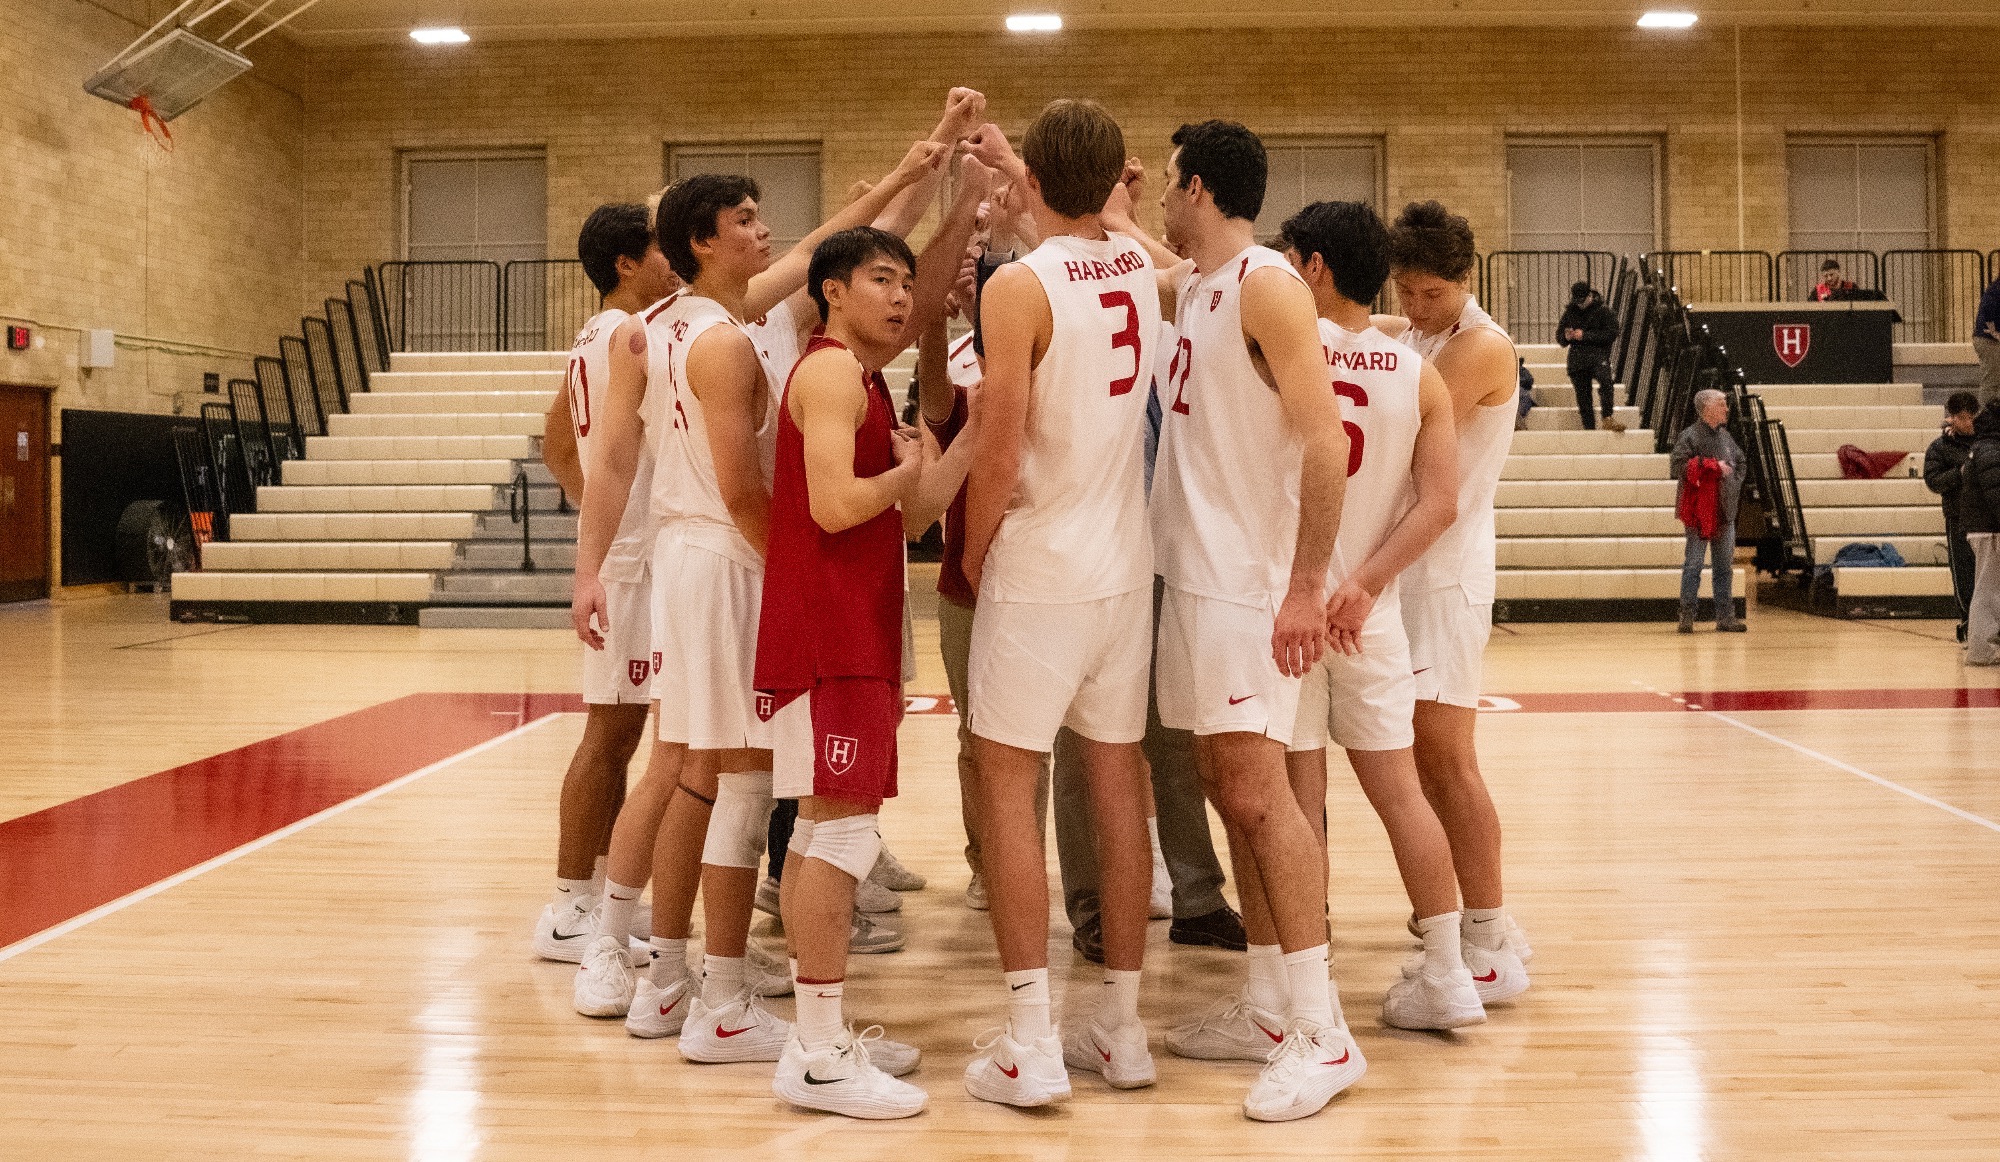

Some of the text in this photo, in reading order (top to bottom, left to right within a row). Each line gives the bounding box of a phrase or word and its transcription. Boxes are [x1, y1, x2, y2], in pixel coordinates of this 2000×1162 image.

[1098, 290, 1142, 398] 3
[1782, 328, 1801, 355] H
[1322, 344, 1398, 372] RVARD
[632, 662, 646, 679] H
[760, 698, 773, 715] H
[831, 740, 850, 764] H
